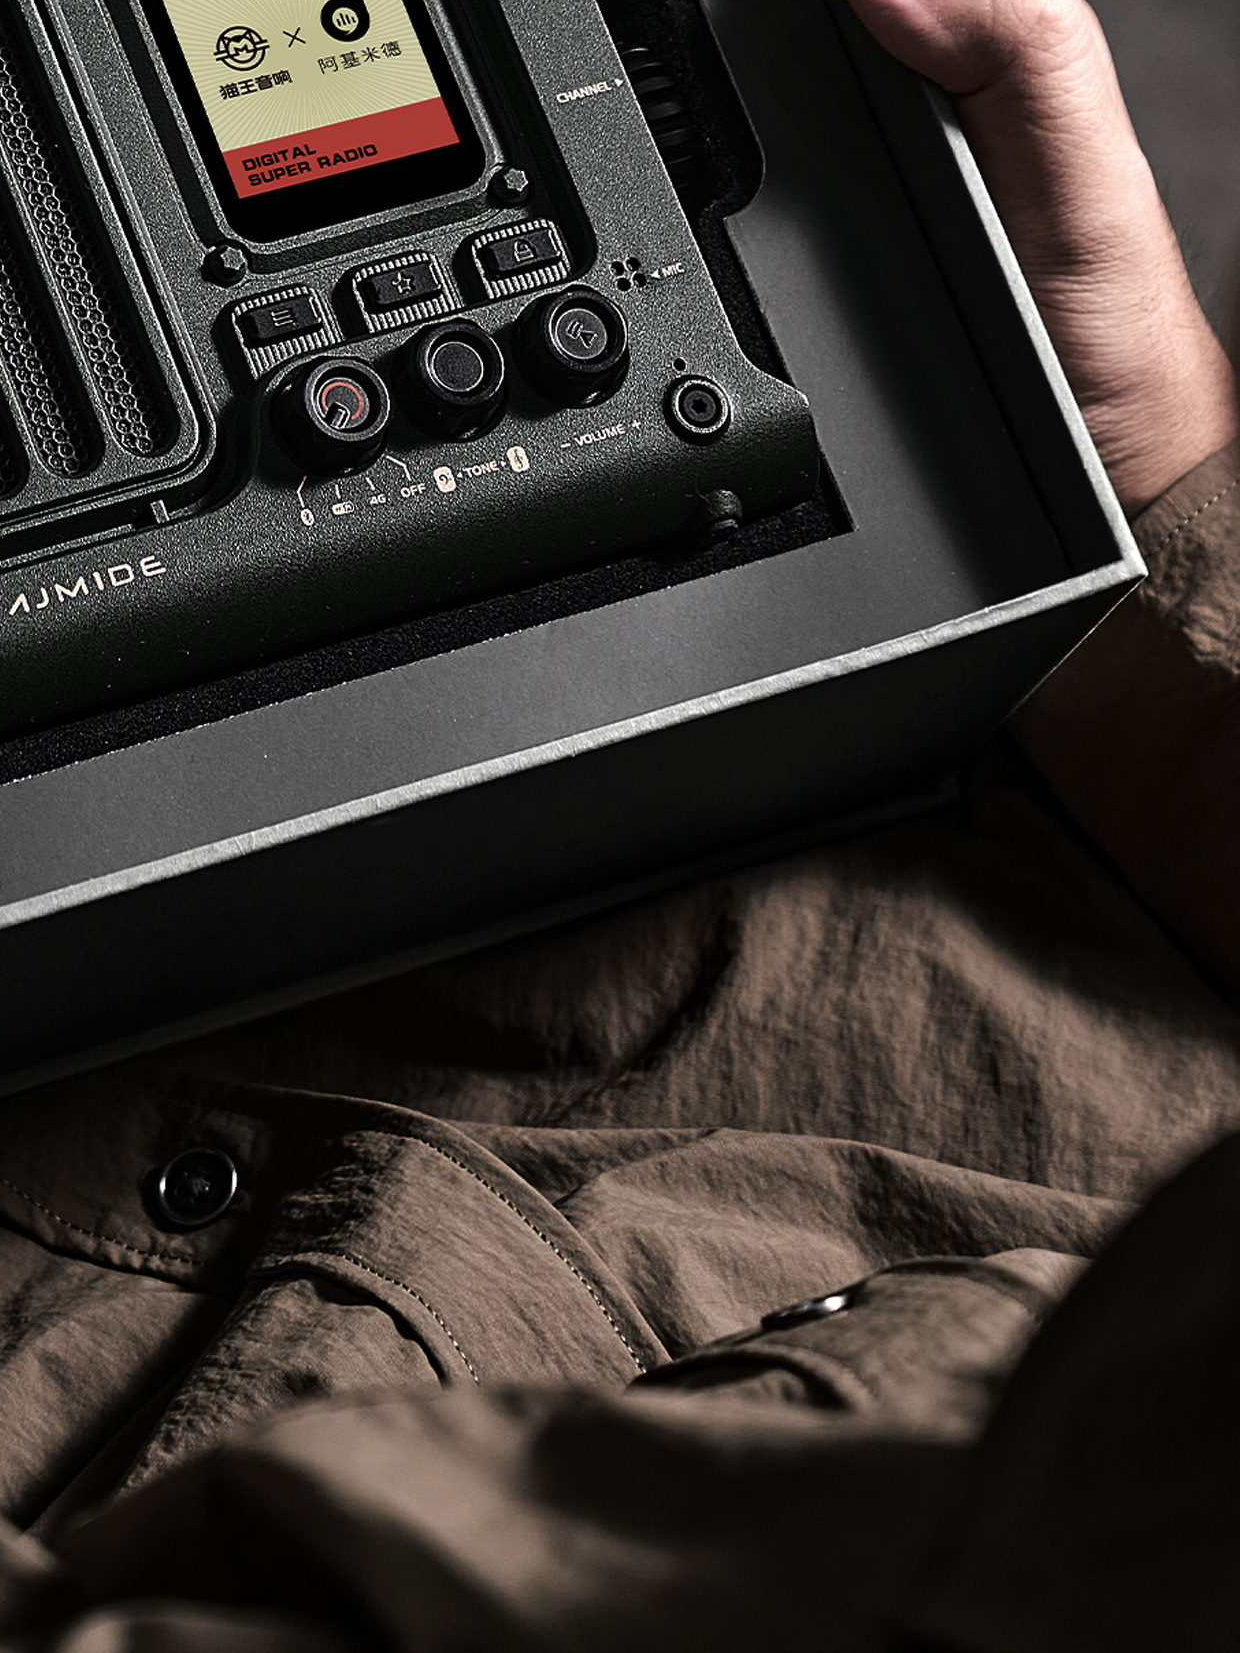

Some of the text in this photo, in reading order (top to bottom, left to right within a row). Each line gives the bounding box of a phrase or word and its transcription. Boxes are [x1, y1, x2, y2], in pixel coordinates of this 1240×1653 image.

[318, 40, 402, 75] 阿基米德
[219, 69, 293, 100] 猫王音响
[556, 81, 612, 104] CHANNEL
[241, 143, 317, 172] DIGITAL
[248, 143, 378, 187] SUPER RADIO
[662, 262, 685, 277] MIC
[573, 423, 626, 446] VOLUME
[464, 459, 499, 479] TONE
[370, 483, 426, 505] 4G OFF
